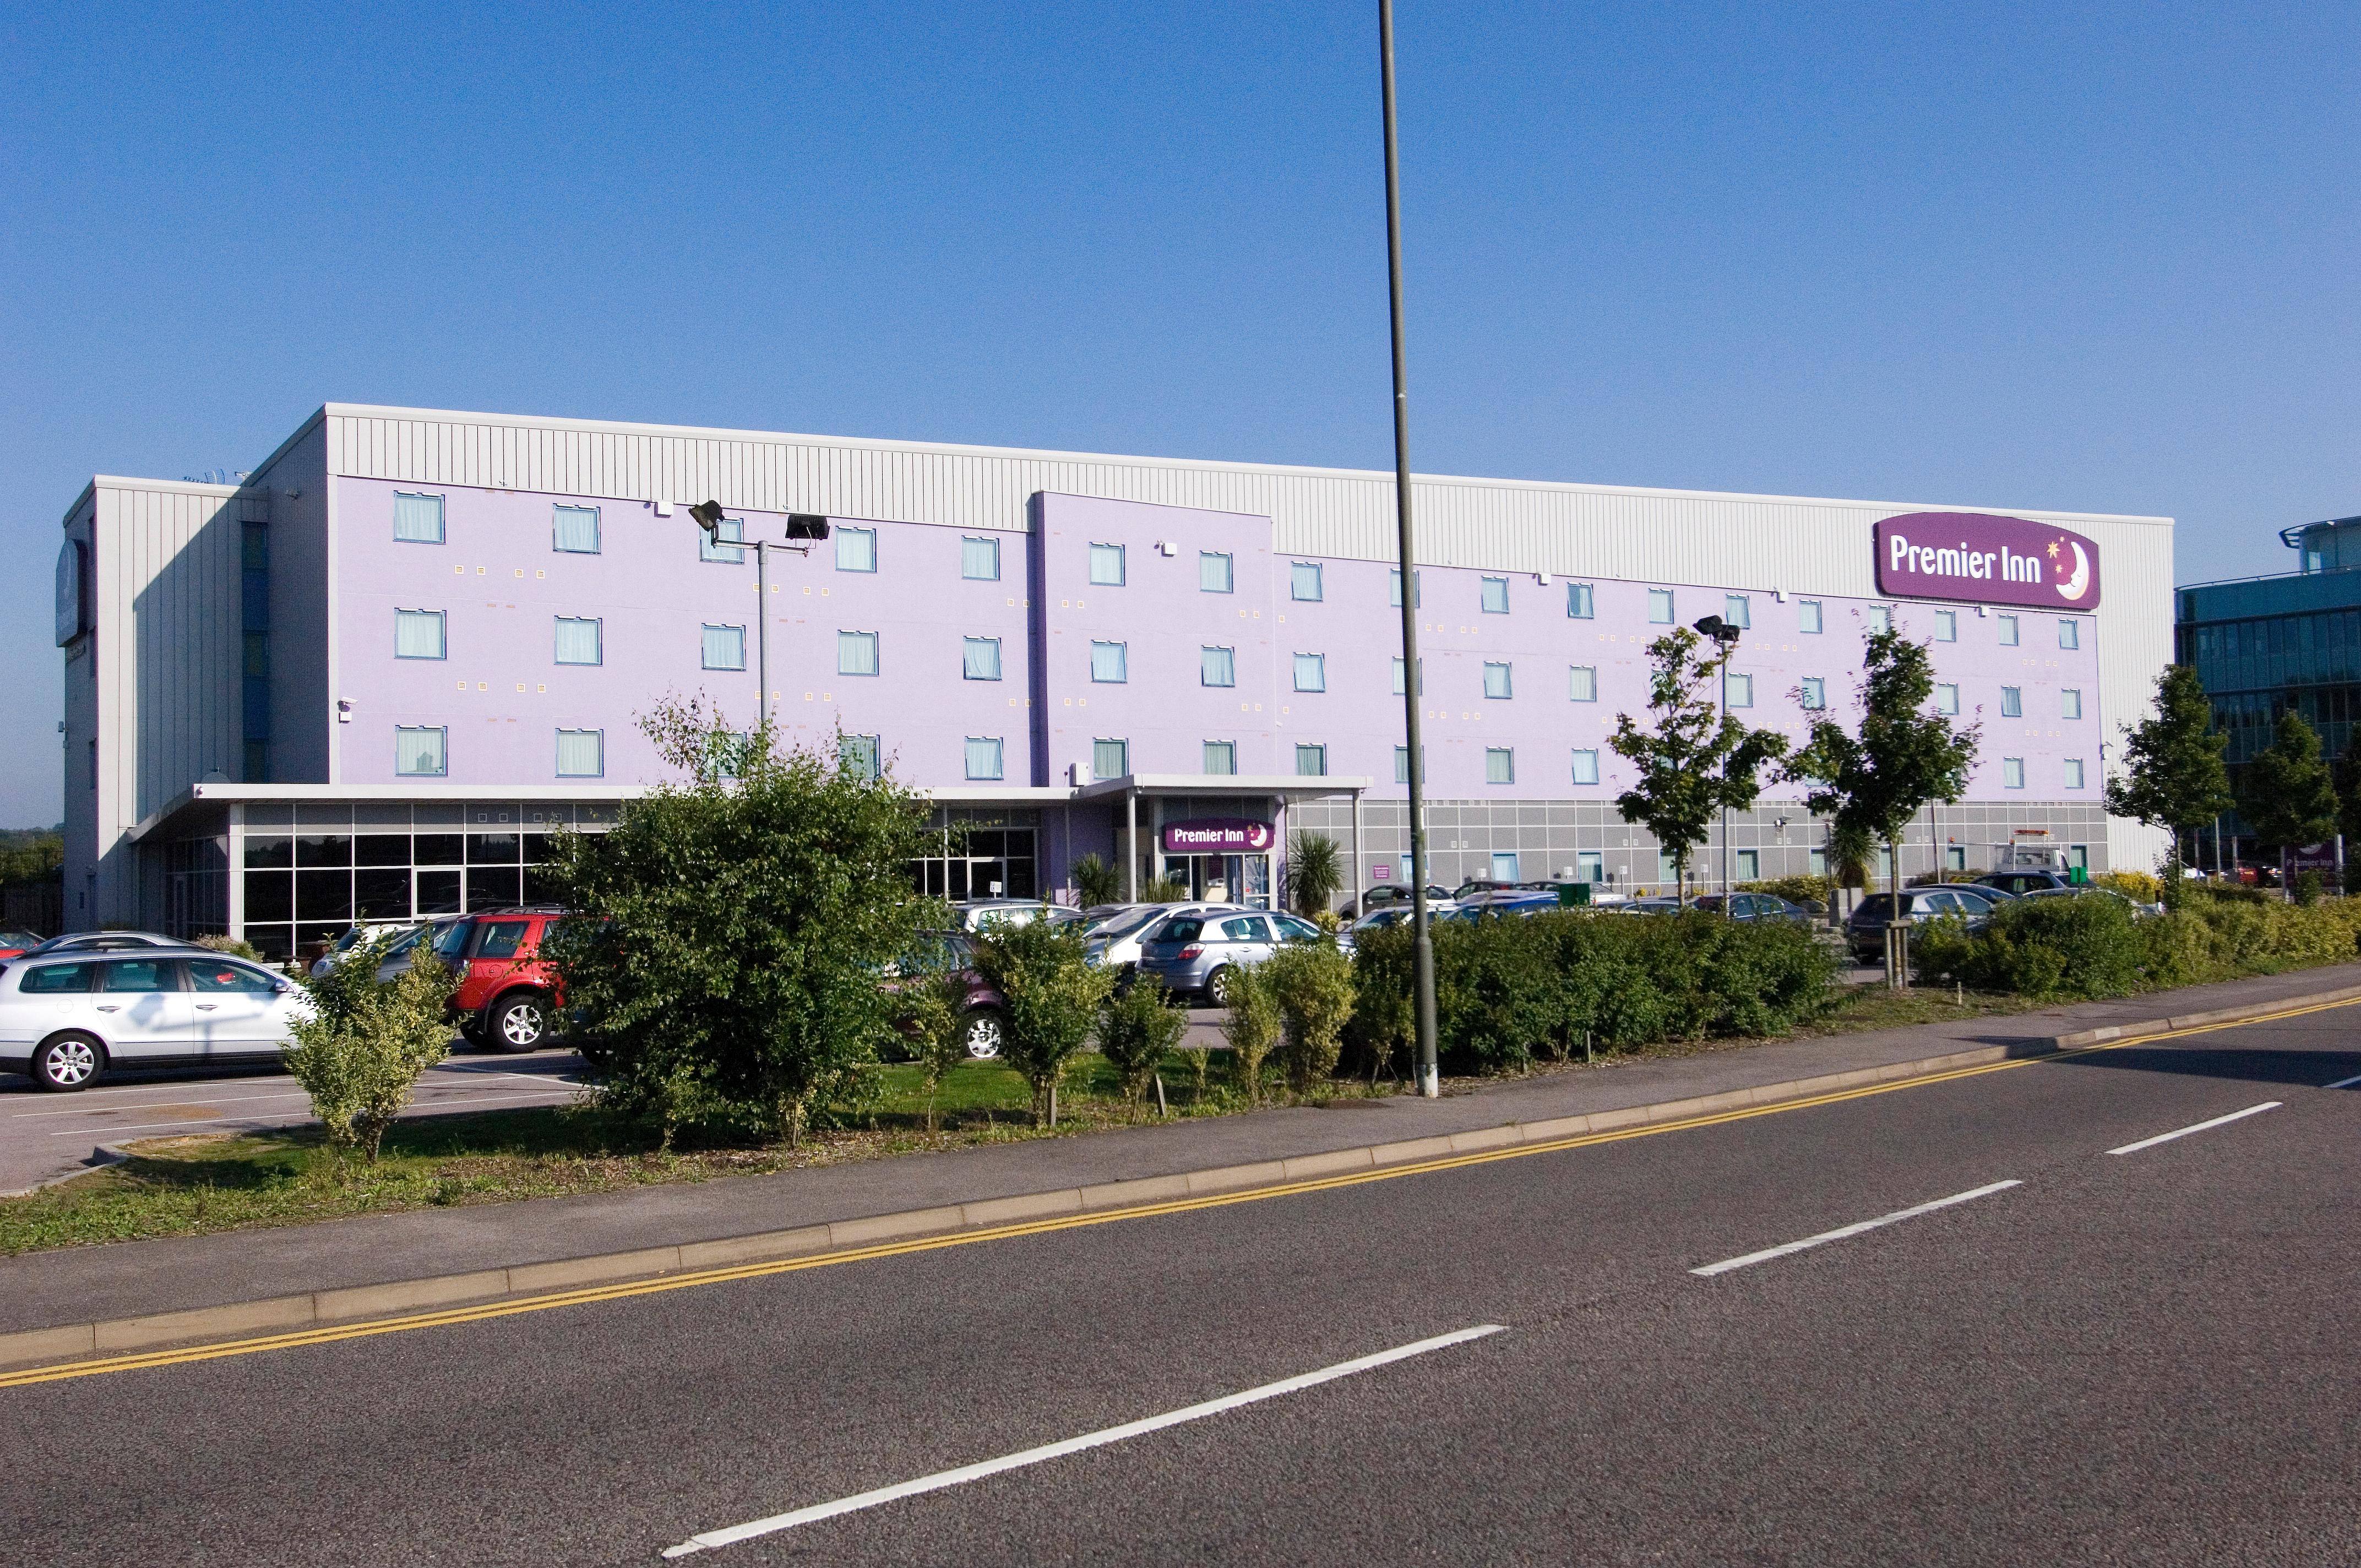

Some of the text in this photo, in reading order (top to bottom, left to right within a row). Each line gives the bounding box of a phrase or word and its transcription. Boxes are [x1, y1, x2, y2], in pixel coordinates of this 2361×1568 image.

[1890, 535, 2041, 583] Premier Inn
[1174, 828, 1243, 842] Premier Inn
